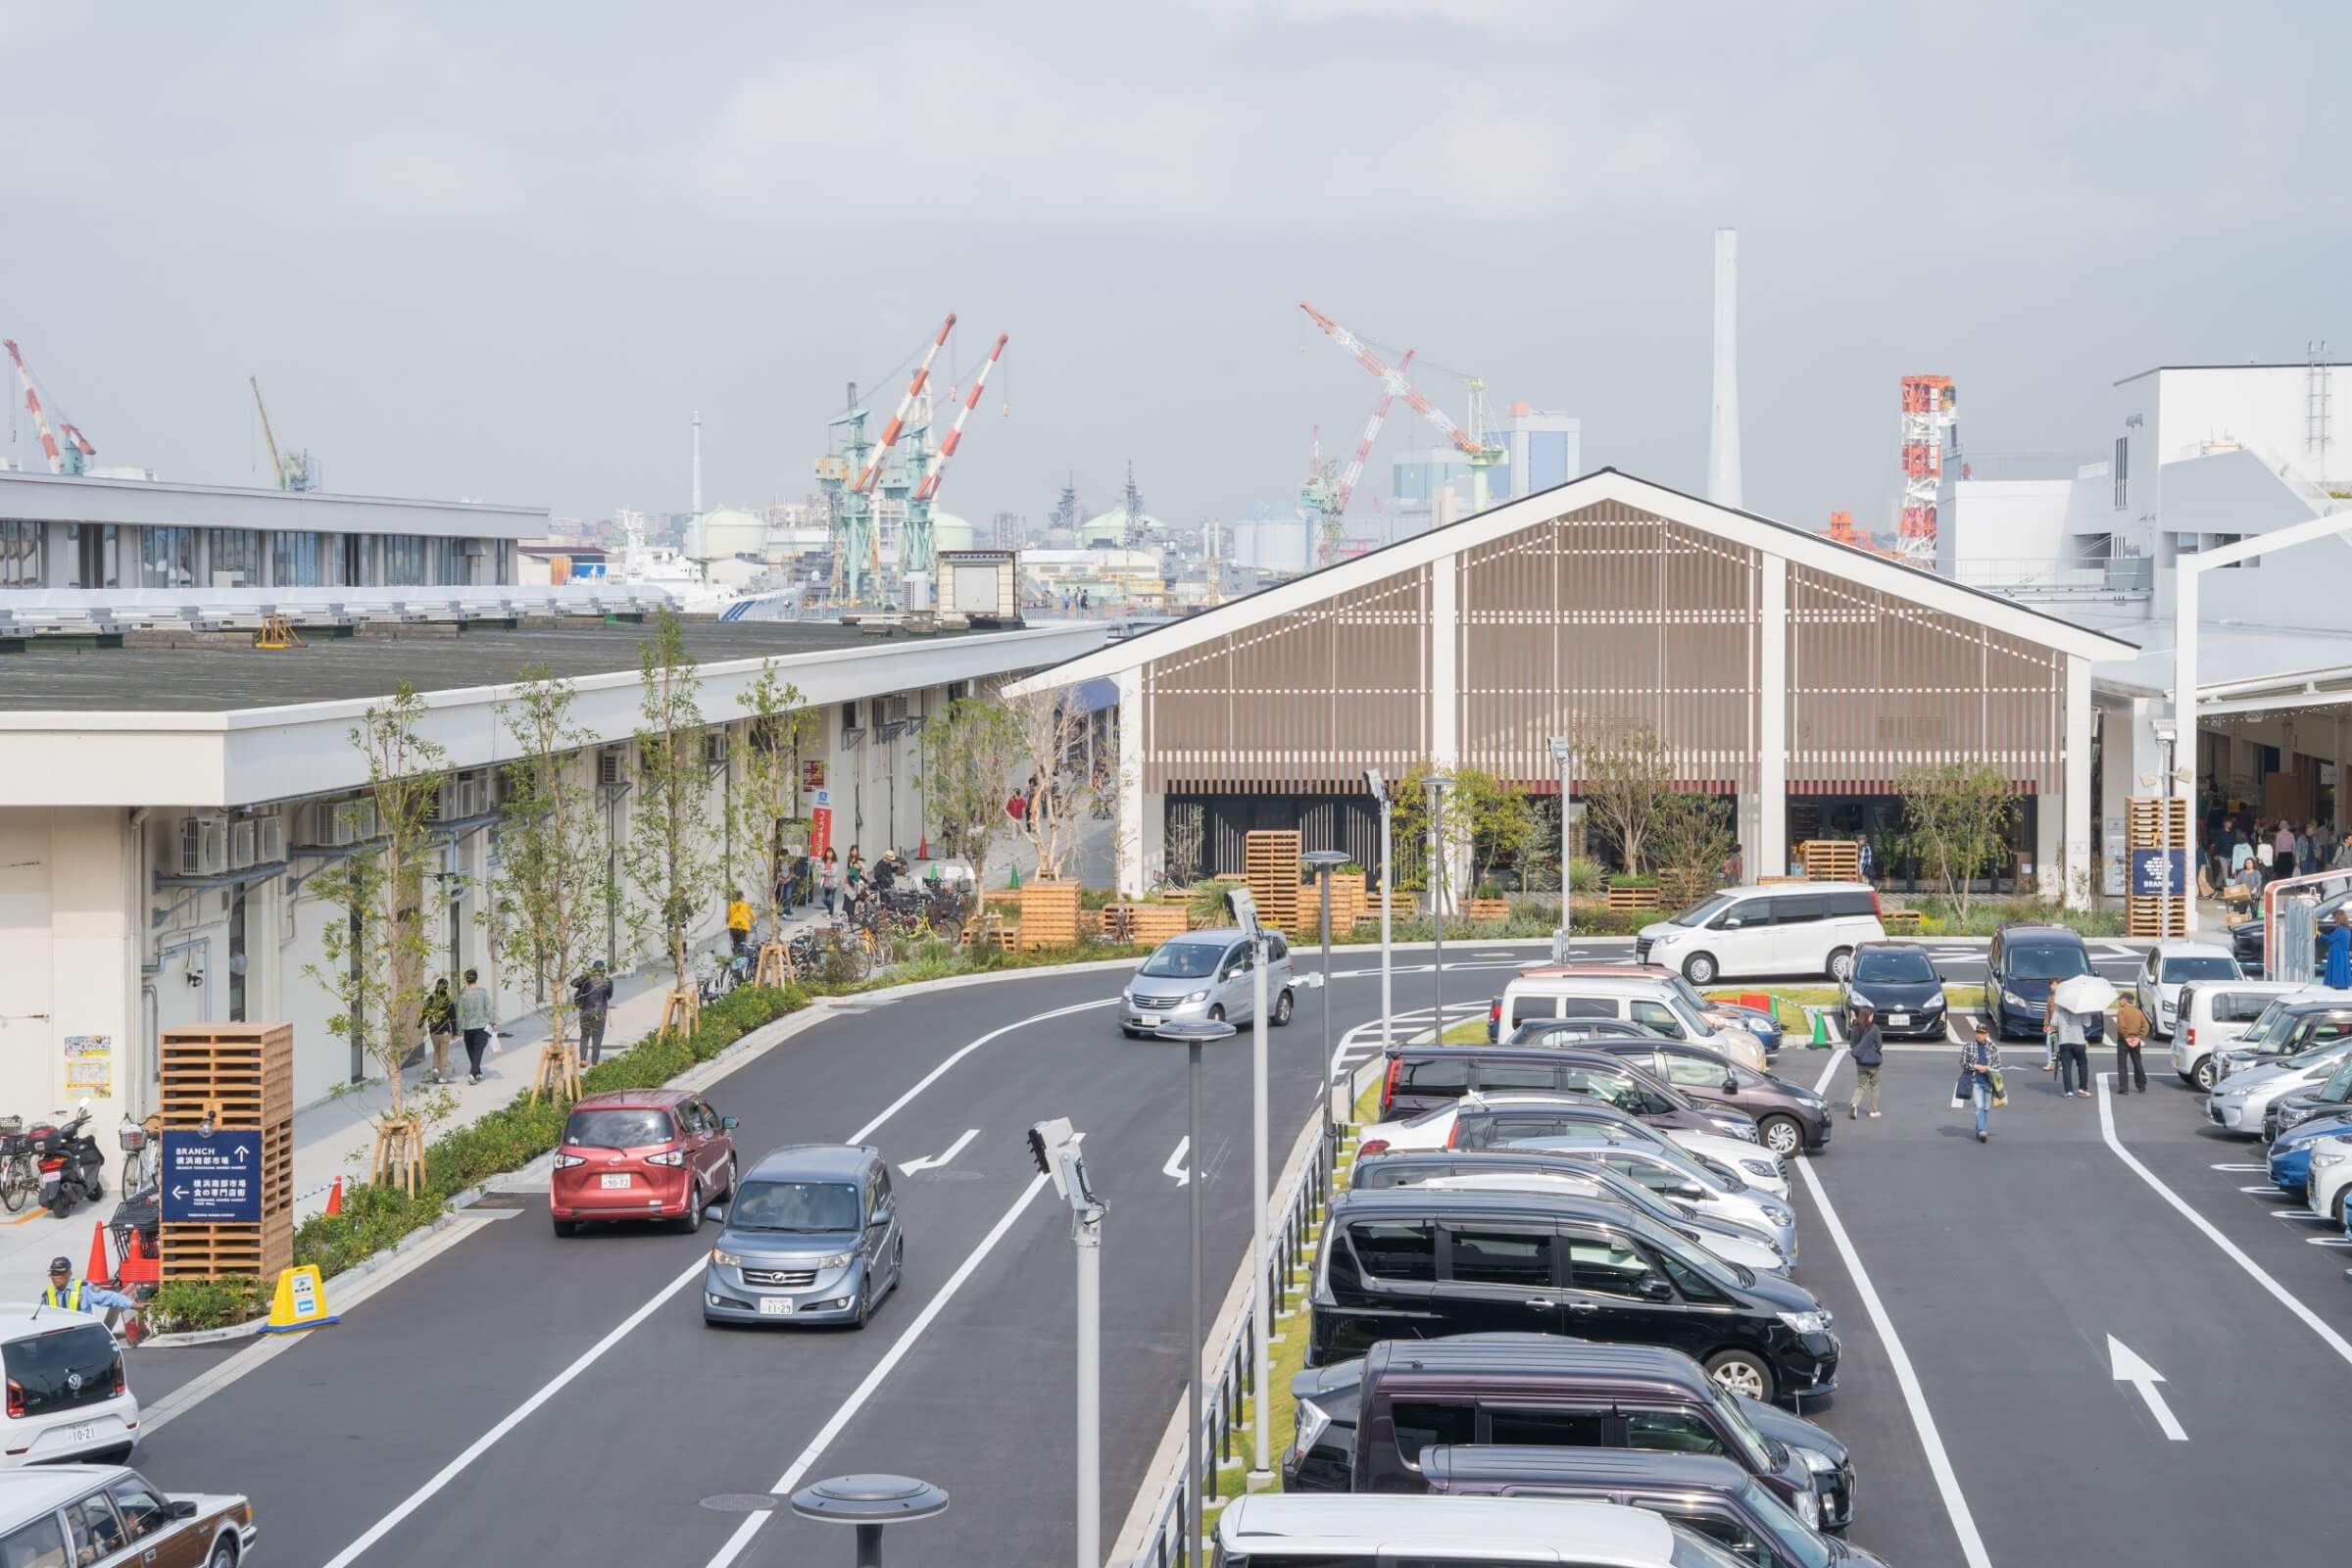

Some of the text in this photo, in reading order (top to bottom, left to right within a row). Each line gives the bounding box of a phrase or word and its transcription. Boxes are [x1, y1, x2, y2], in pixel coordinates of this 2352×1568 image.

[175, 1156, 229, 1165] 横浜南部市場
[193, 1179, 247, 1188] 横浜南部市場
[193, 1188, 246, 1197] 食の専門店街
